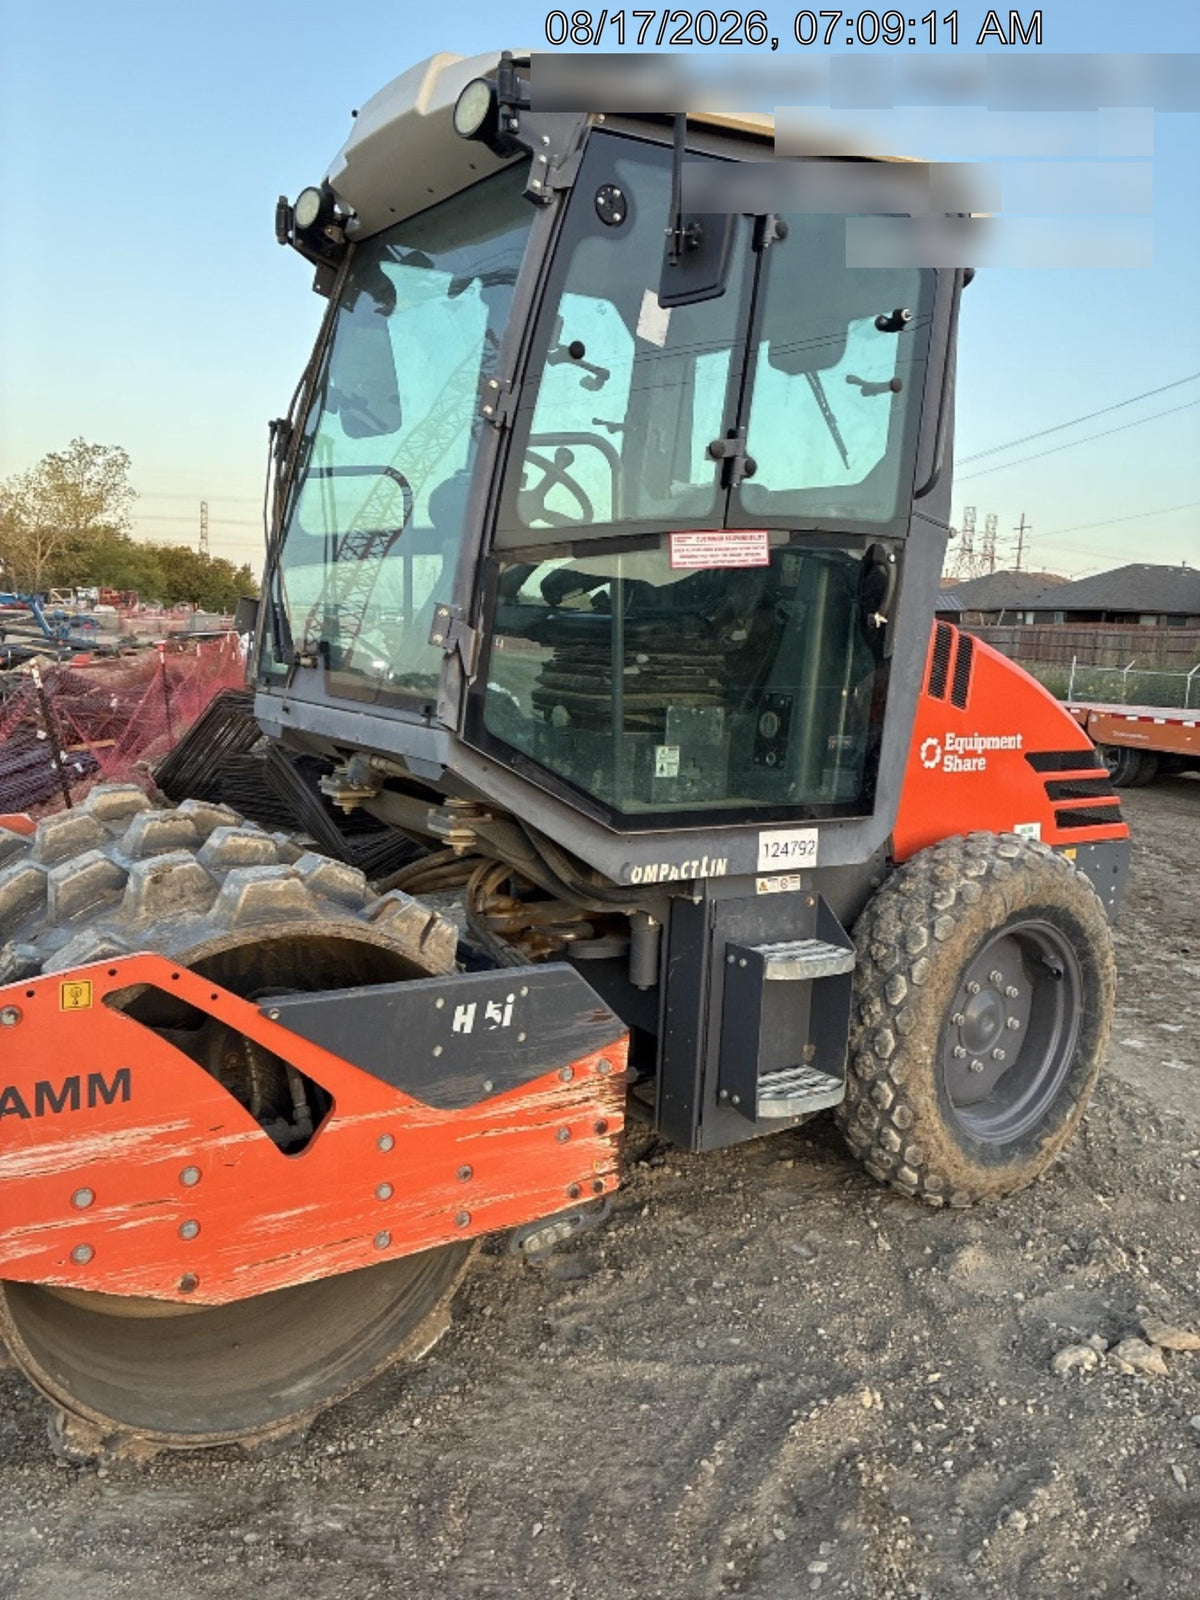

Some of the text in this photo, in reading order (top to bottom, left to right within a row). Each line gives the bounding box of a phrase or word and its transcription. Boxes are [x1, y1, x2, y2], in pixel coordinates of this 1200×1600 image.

[944, 732, 1023, 754] Equipment
[943, 755, 987, 773] Share
[763, 839, 816, 858] 124792
[0, 1068, 131, 1120] AMM
